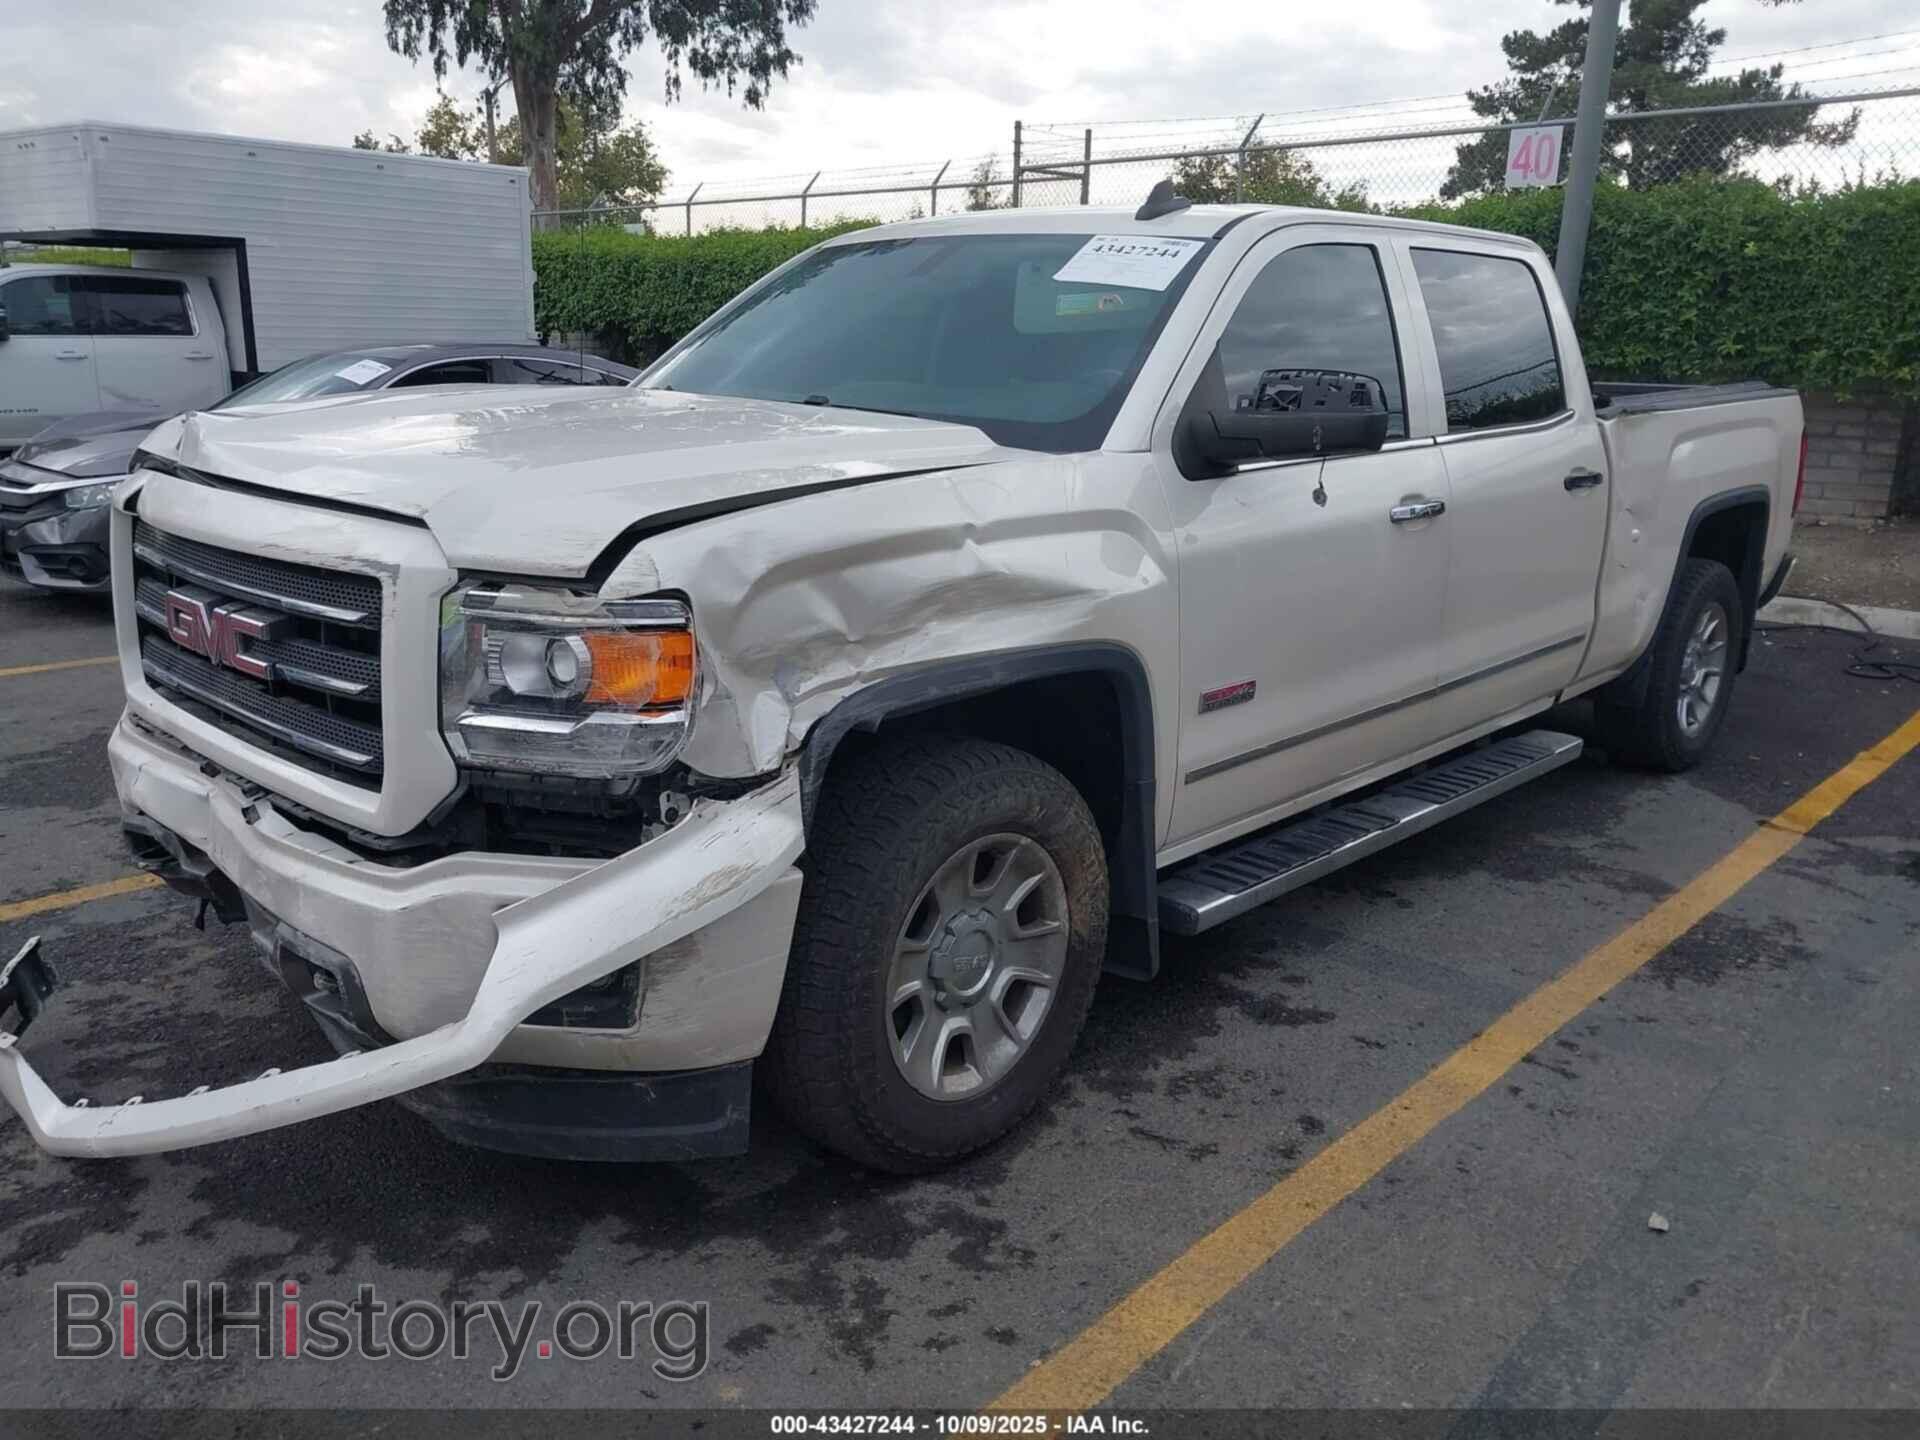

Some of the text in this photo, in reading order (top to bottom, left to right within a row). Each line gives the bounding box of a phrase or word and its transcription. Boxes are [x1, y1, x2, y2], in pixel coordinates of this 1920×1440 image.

[1511, 133, 1556, 181] 40
[1093, 244, 1181, 258] 43427244
[166, 590, 273, 682] GMC
